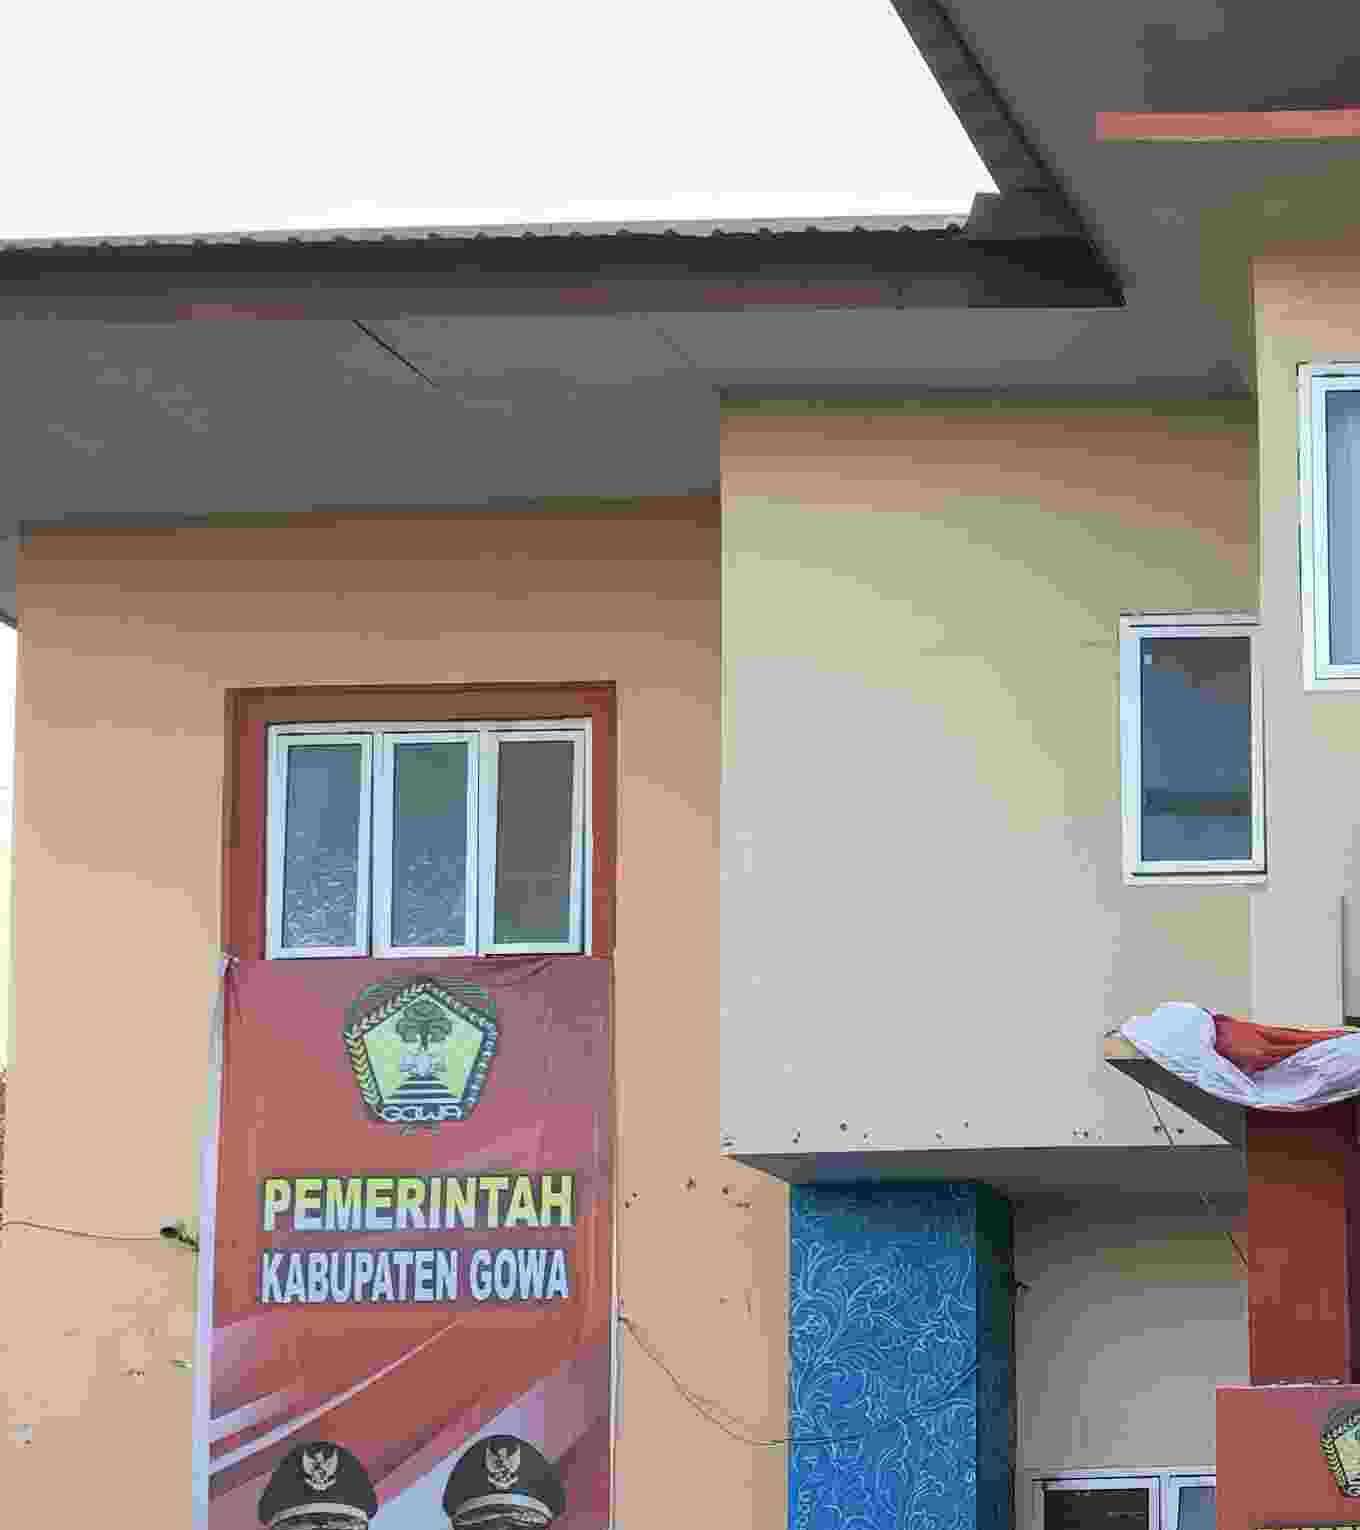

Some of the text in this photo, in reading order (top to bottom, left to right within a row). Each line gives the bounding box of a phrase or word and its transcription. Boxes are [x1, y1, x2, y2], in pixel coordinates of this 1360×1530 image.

[381, 1103, 465, 1122] GOWA
[263, 1174, 575, 1232] PEMERINTAH
[262, 1249, 569, 1304] KABUPATEN GOWA
